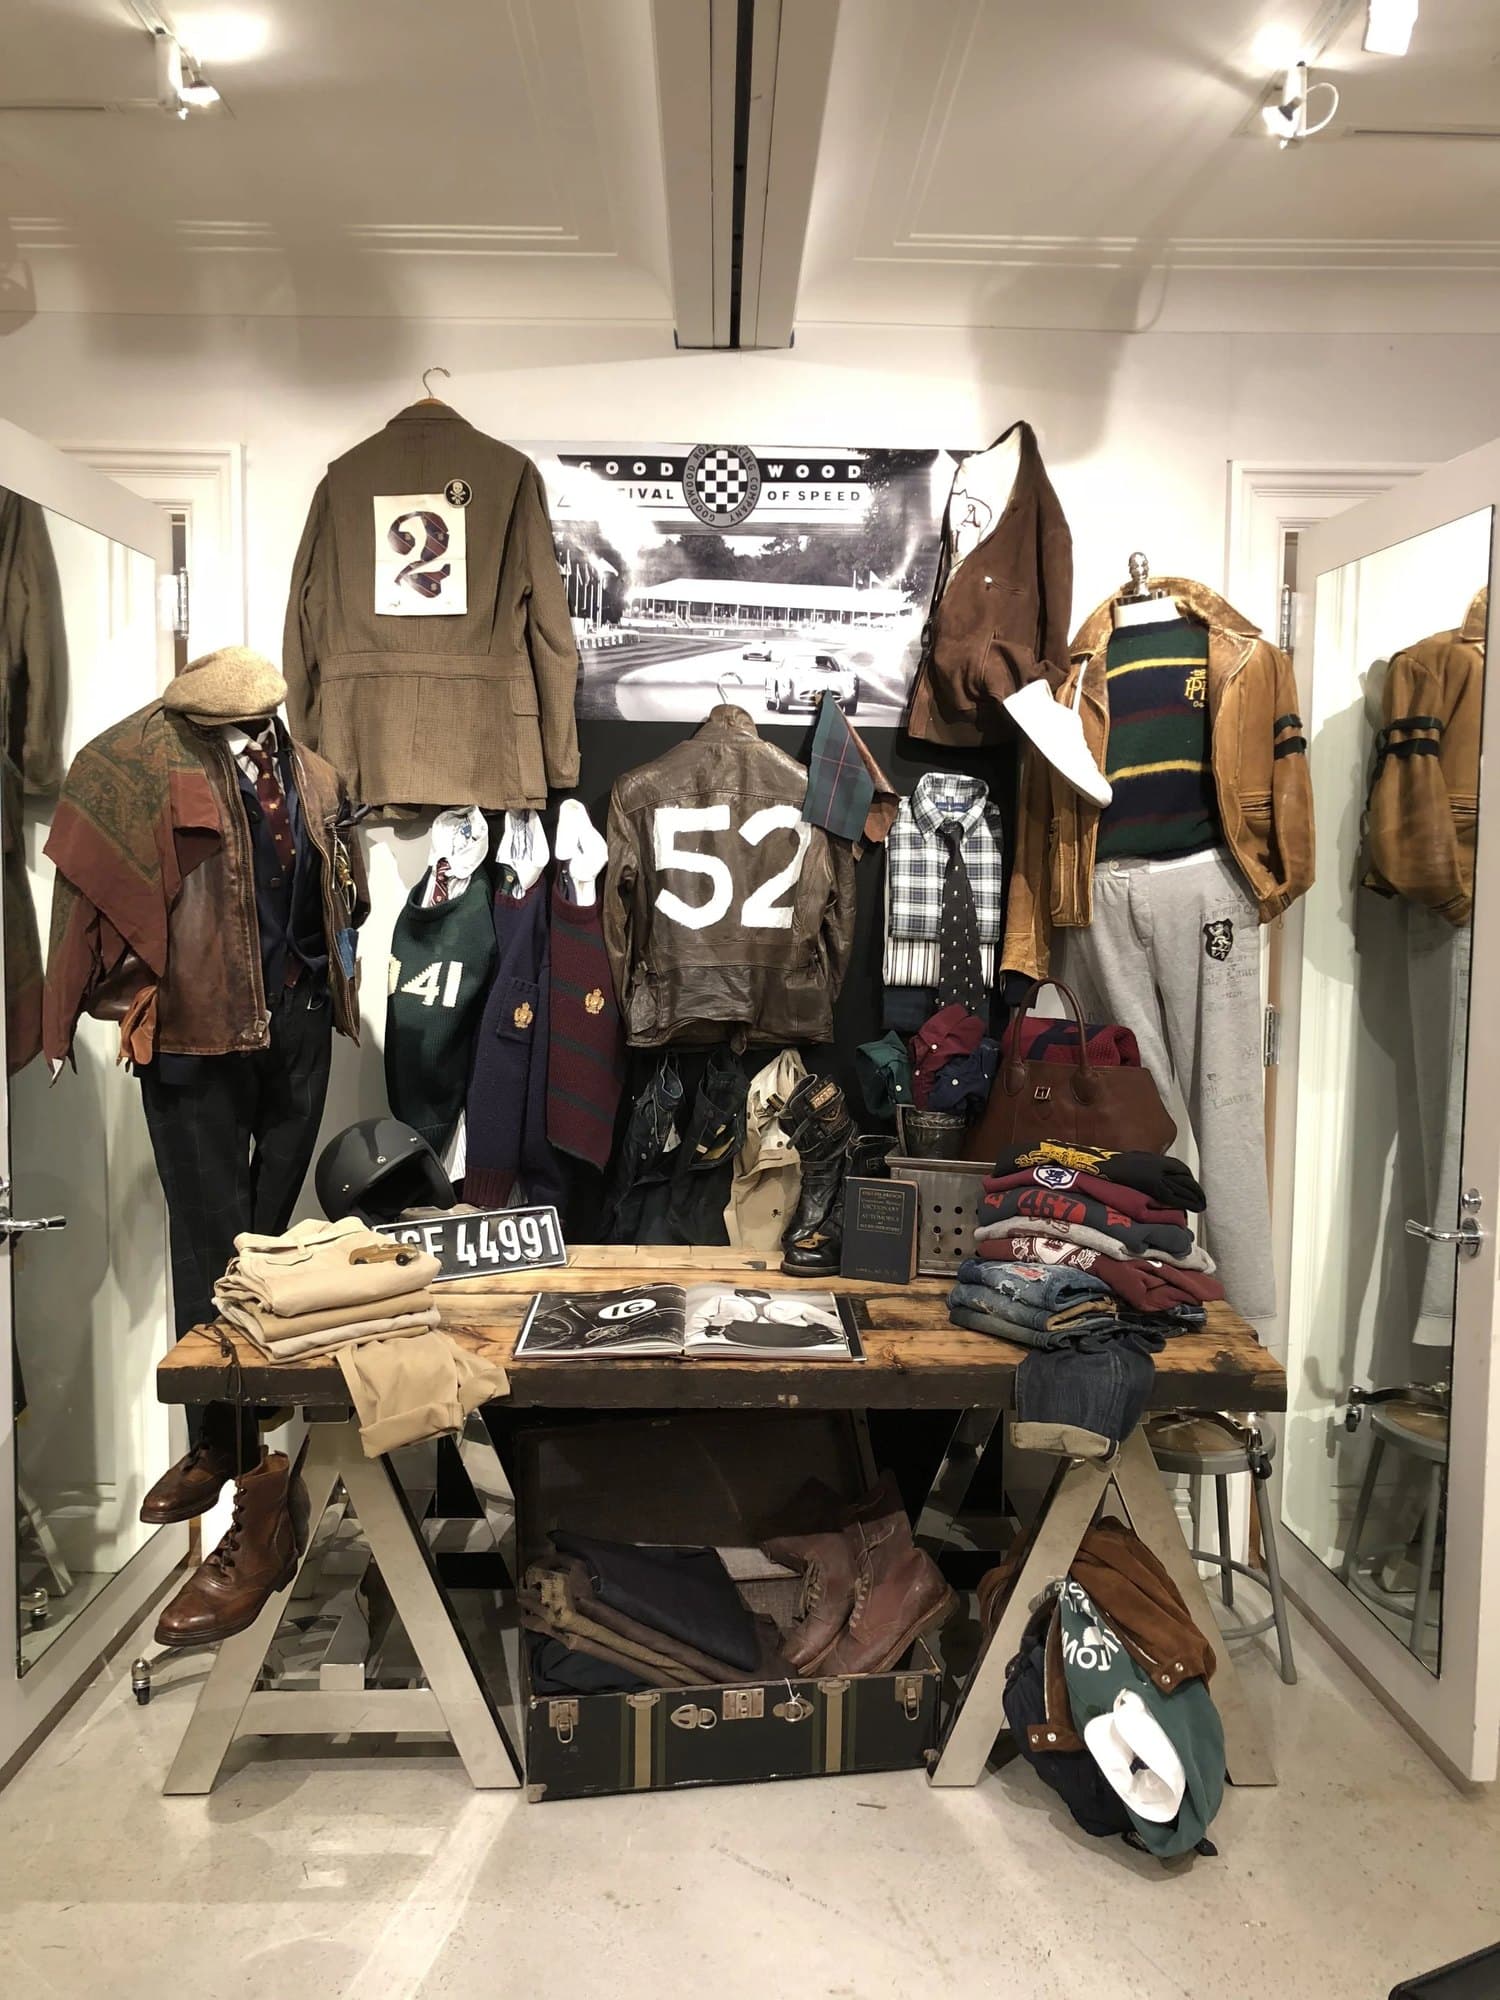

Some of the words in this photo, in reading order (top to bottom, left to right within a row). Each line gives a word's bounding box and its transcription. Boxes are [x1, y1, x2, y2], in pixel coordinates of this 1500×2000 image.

[685, 464, 716, 523] GOODWOOD
[728, 476, 758, 523] COMPANY
[767, 463, 861, 479] WOOD
[767, 490, 790, 501] OF
[798, 490, 861, 502] SPEED
[387, 511, 451, 598] 2
[654, 804, 812, 930] 52
[456, 1214, 559, 1268] 44991
[611, 1301, 645, 1317] 16
